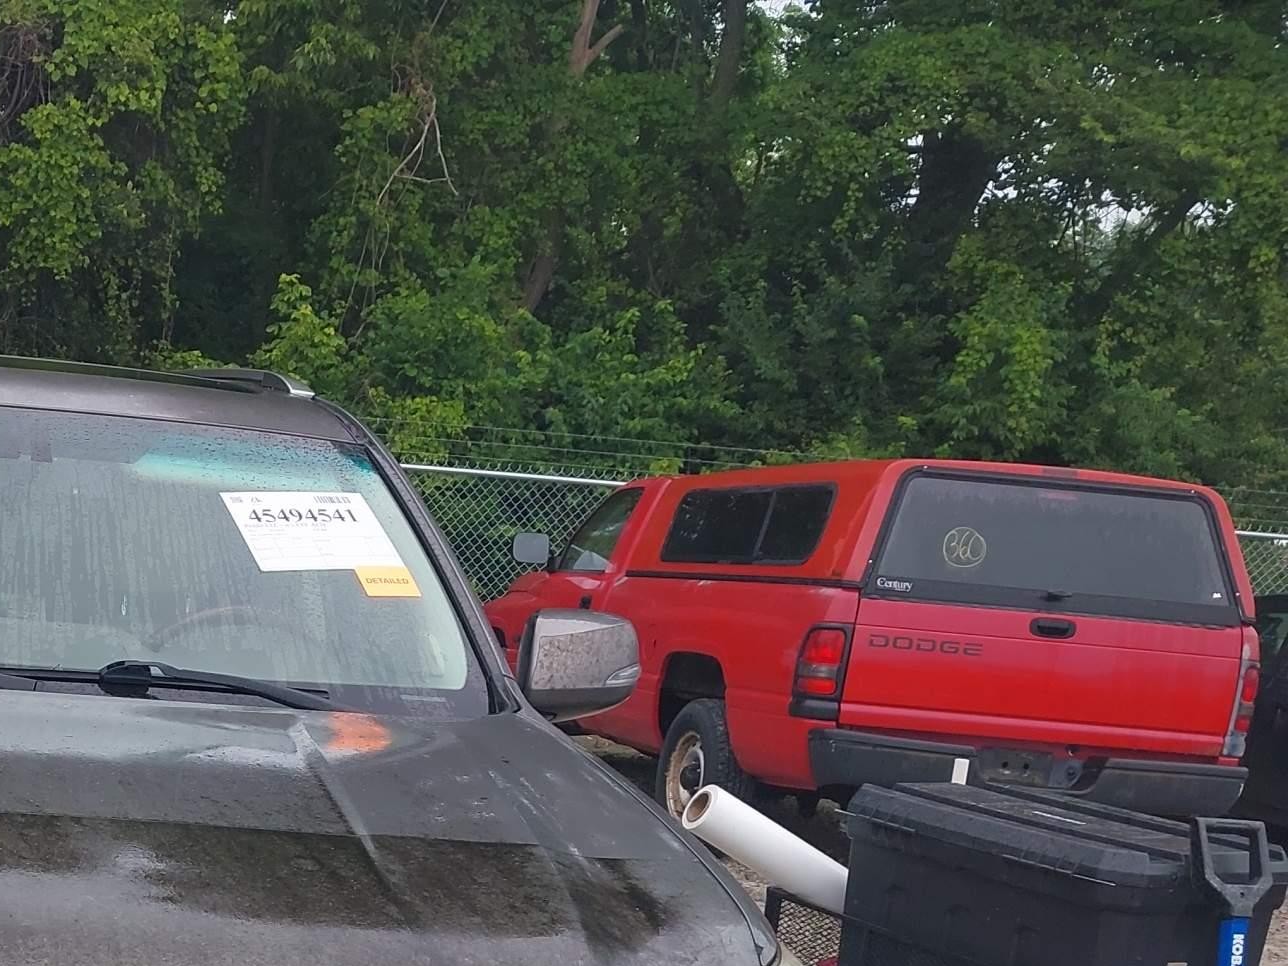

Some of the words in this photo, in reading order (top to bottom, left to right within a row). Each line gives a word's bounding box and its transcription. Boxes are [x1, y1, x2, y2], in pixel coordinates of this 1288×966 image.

[249, 508, 359, 523] 45494541
[945, 529, 985, 561] 360
[365, 577, 409, 585] DETAILED
[876, 577, 913, 592] Century
[869, 634, 983, 656] DODGE
